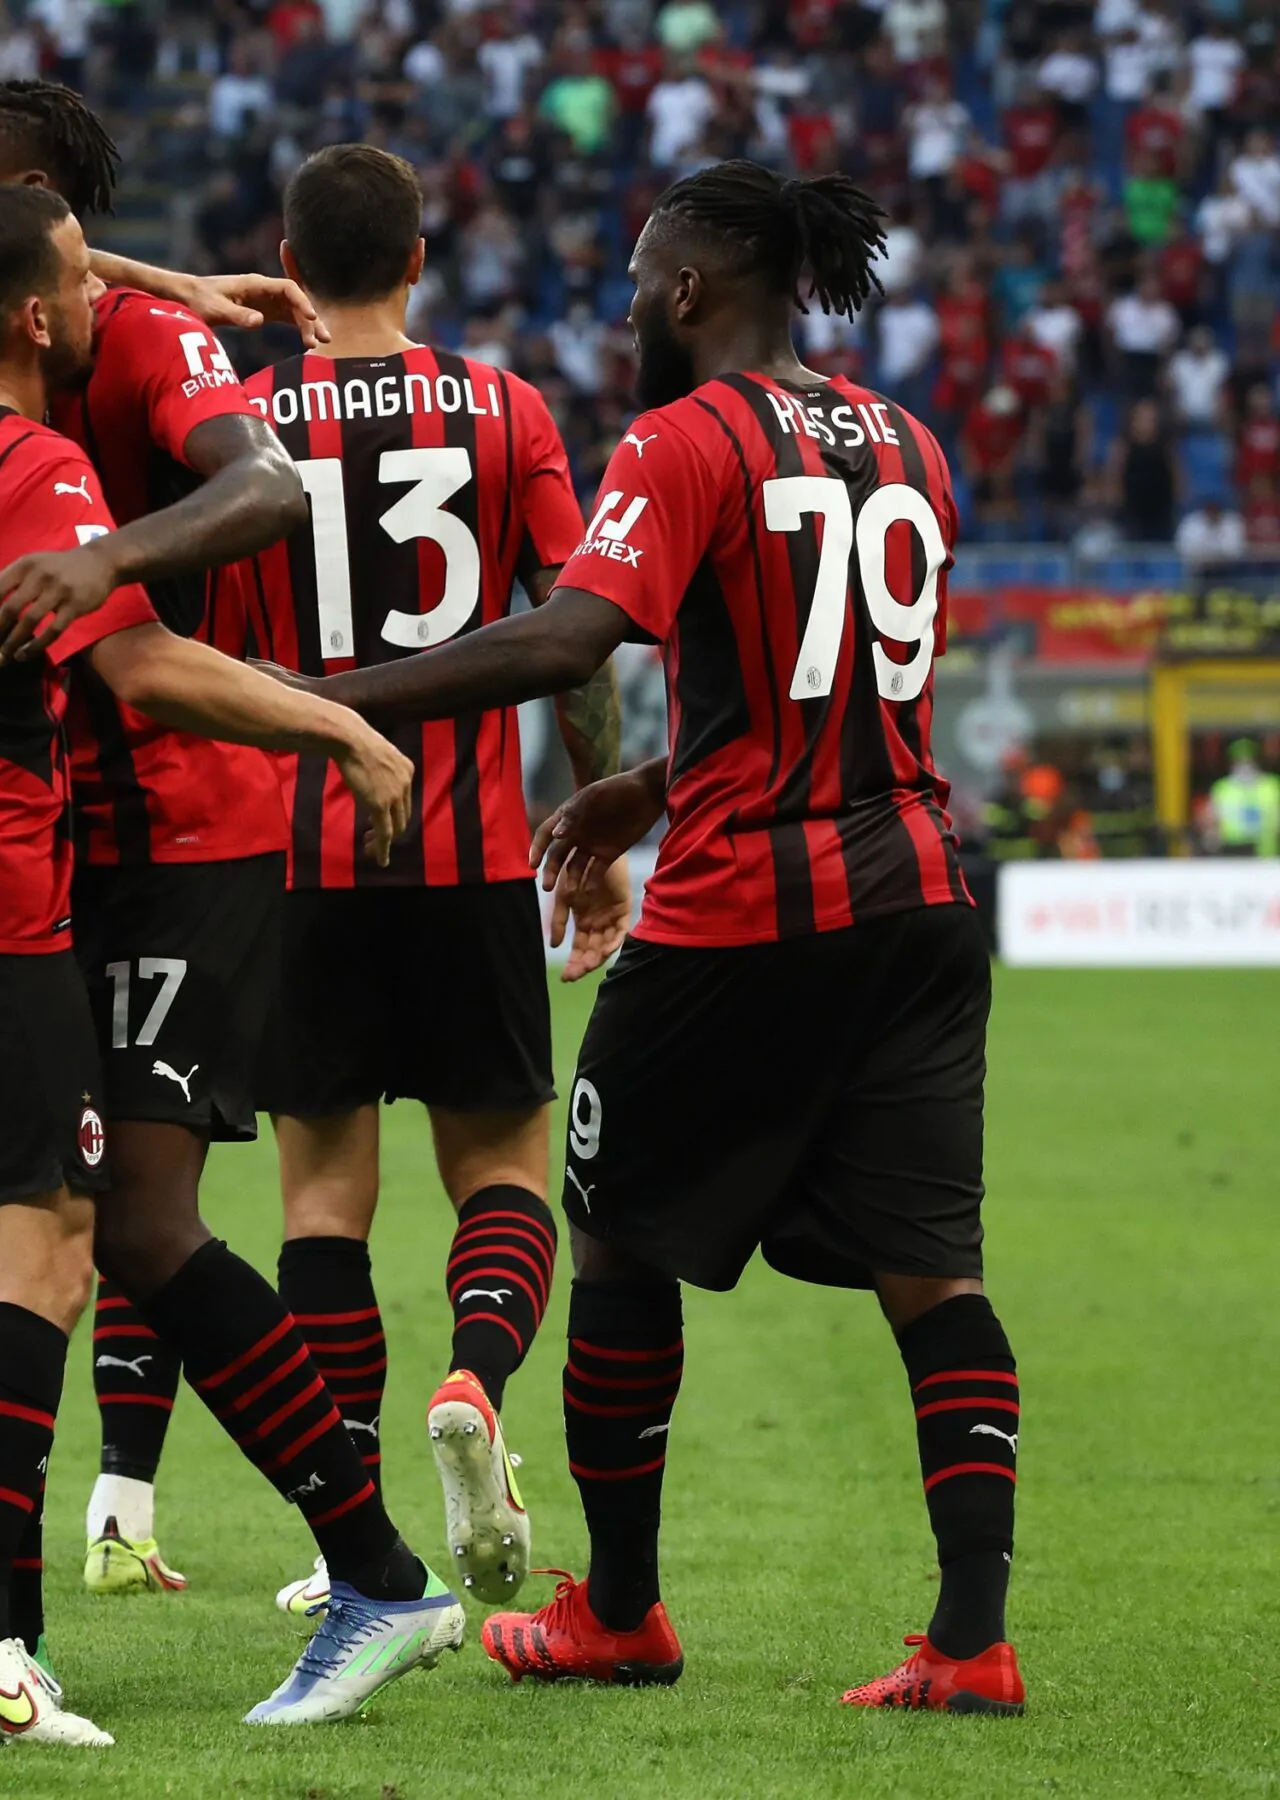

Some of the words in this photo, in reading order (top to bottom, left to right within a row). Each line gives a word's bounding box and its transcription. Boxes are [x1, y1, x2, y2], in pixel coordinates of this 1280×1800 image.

[181, 368, 241, 398] BitM
[766, 392, 900, 447] KESSIE
[294, 447, 481, 659] 13
[569, 538, 645, 569] itMEX
[762, 475, 947, 702] 79
[105, 956, 187, 1049] 17
[570, 1077, 602, 1160] 9
